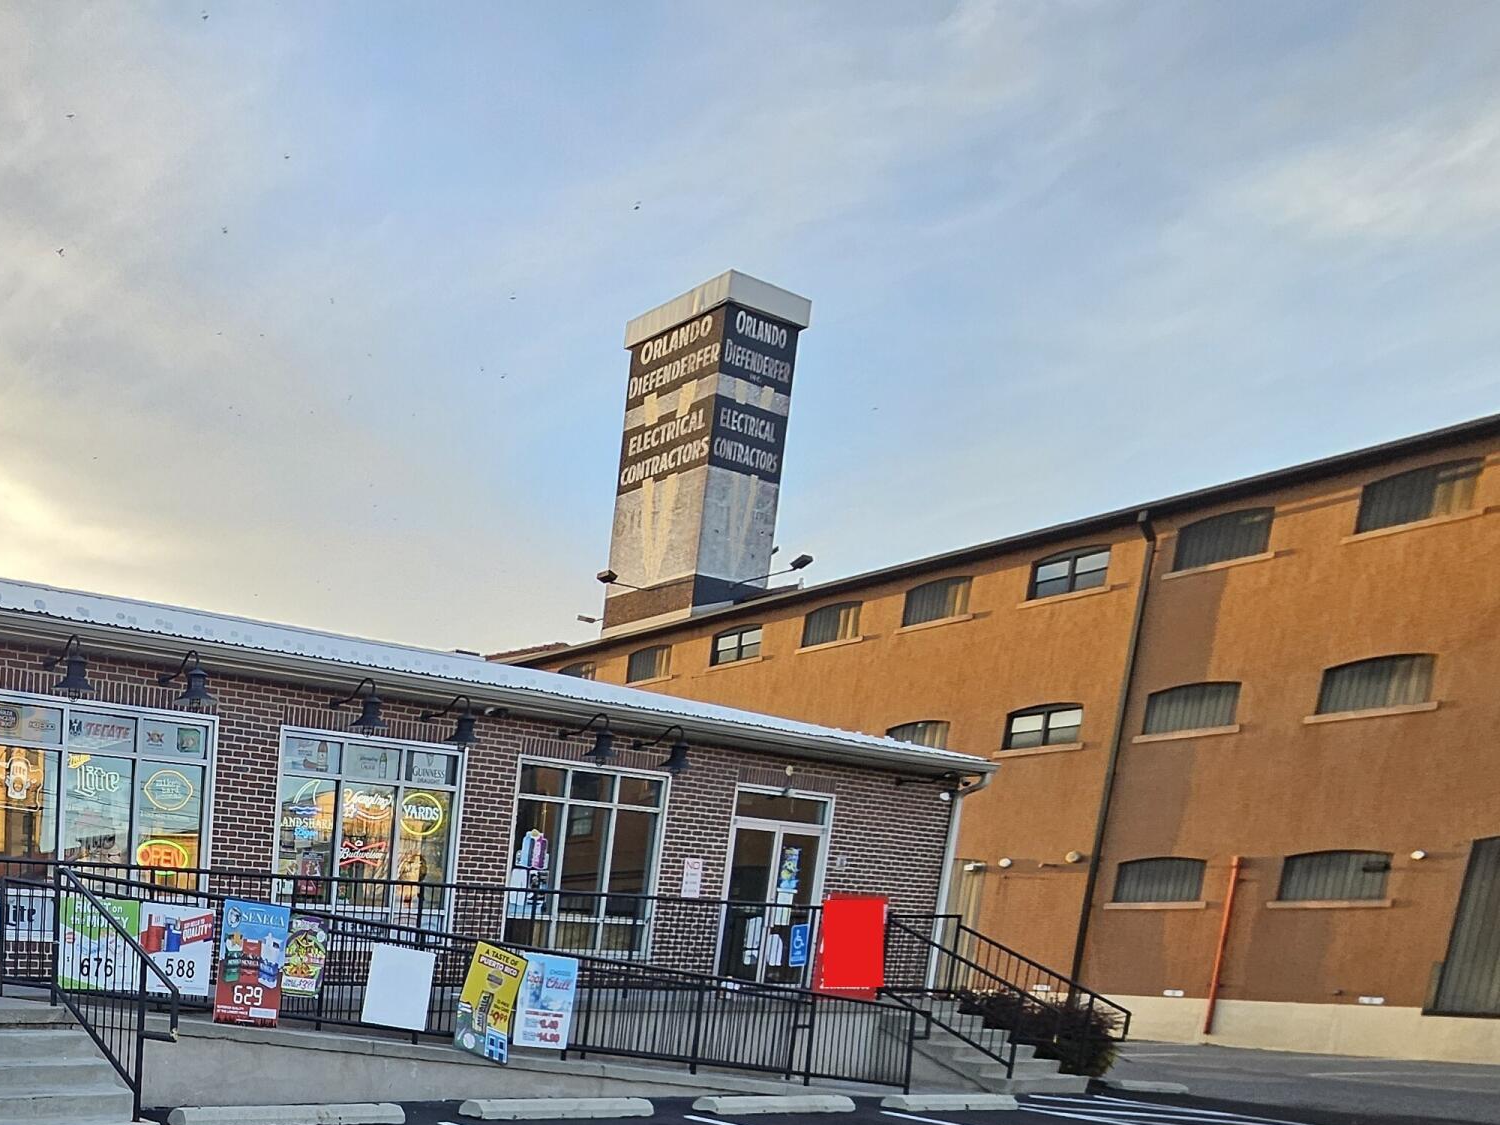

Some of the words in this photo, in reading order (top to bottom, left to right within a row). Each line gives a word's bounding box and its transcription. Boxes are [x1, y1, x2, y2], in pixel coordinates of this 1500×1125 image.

[641, 315, 712, 365] ORLANDO
[735, 311, 787, 349] ORLANDO
[627, 341, 721, 401] DIEFENDERFER
[723, 338, 791, 385] DIEFENDERFER
[628, 407, 707, 458] ELECTRICAL
[719, 406, 776, 443] ELECTRICAL
[619, 436, 710, 487] CONTRACTORS
[713, 437, 779, 474] CONTRACTORS
[84, 721, 132, 739] TECATE
[412, 765, 445, 779] GUINNESS
[403, 804, 440, 821] YARDS
[140, 846, 184, 867] OPEN
[686, 860, 700, 870] NO
[112, 905, 123, 913] on
[241, 910, 285, 927] SENECA
[80, 957, 114, 977] 676
[165, 958, 195, 978] 588
[480, 956, 504, 972] PUERTO
[504, 967, 518, 977] RICO
[485, 948, 491, 956] A
[491, 950, 510, 965] TASTE
[509, 958, 519, 967] OF
[233, 985, 263, 1006] 629
